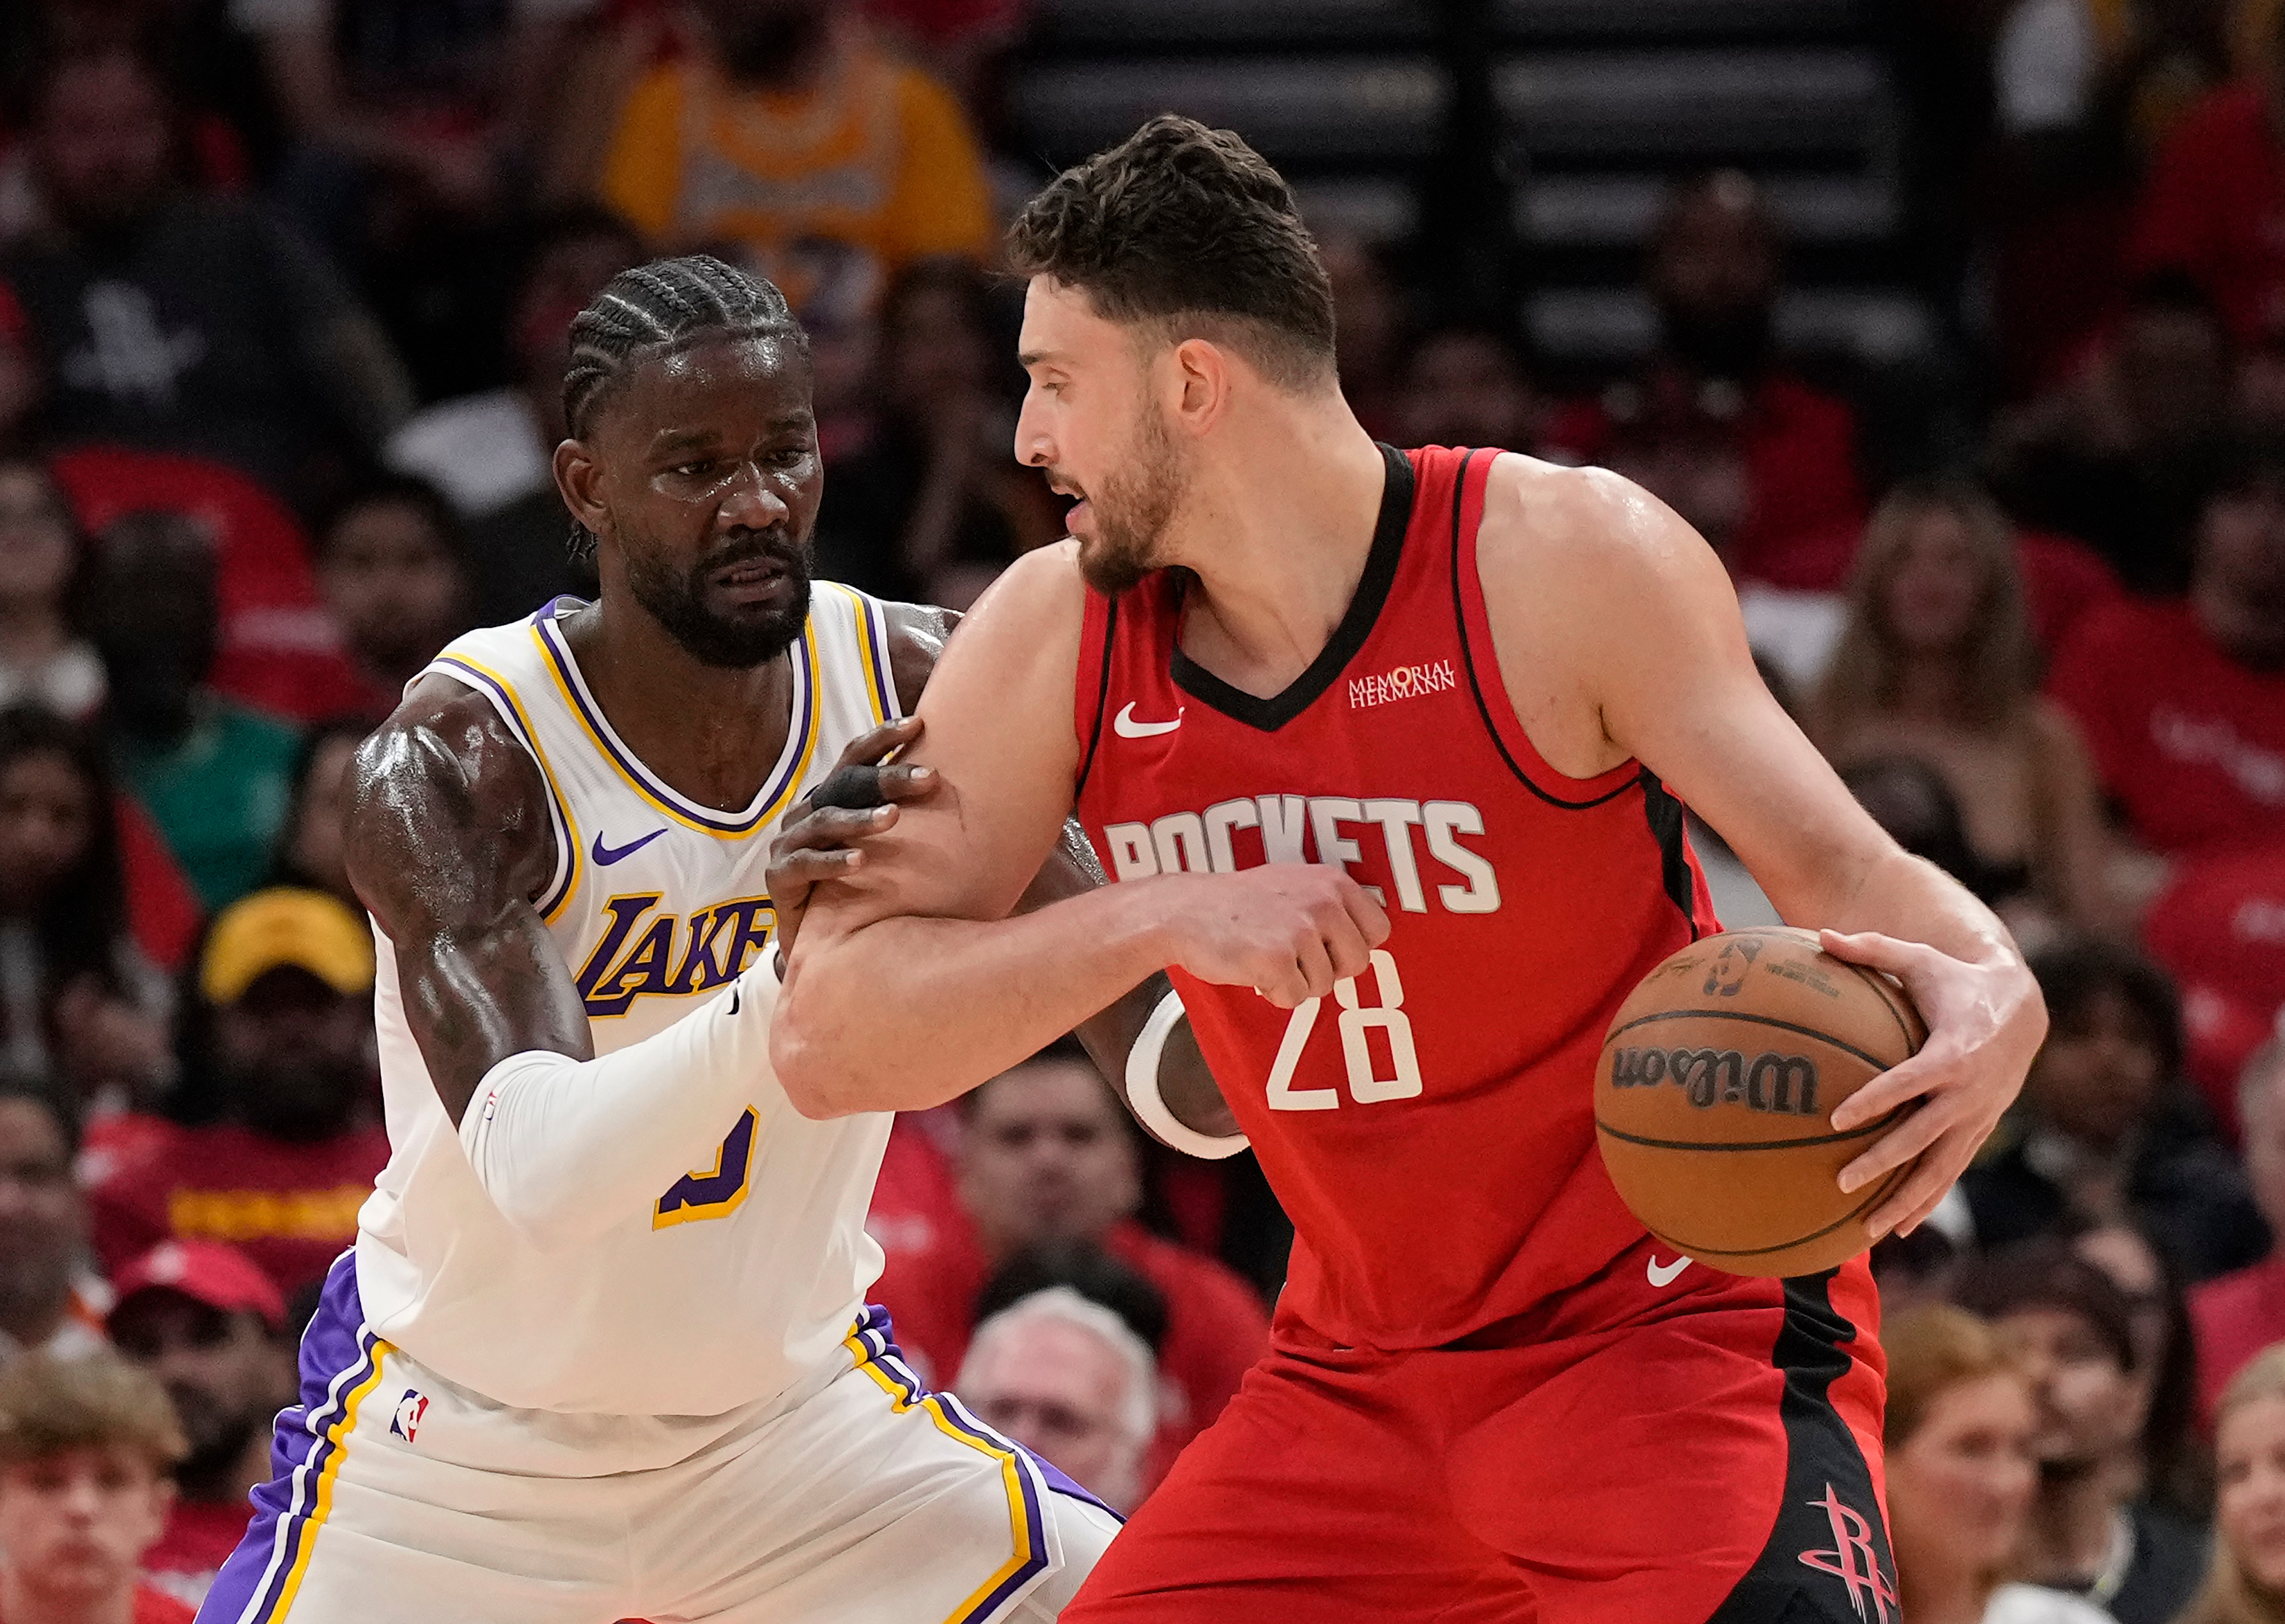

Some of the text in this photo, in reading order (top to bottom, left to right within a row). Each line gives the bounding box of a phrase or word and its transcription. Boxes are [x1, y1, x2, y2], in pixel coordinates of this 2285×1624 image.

[1349, 659, 1454, 695] MEMORIAL
[1350, 670, 1455, 709] HERMANN
[1253, 949, 1424, 1111] 28
[1611, 1046, 1819, 1116] Wilson
